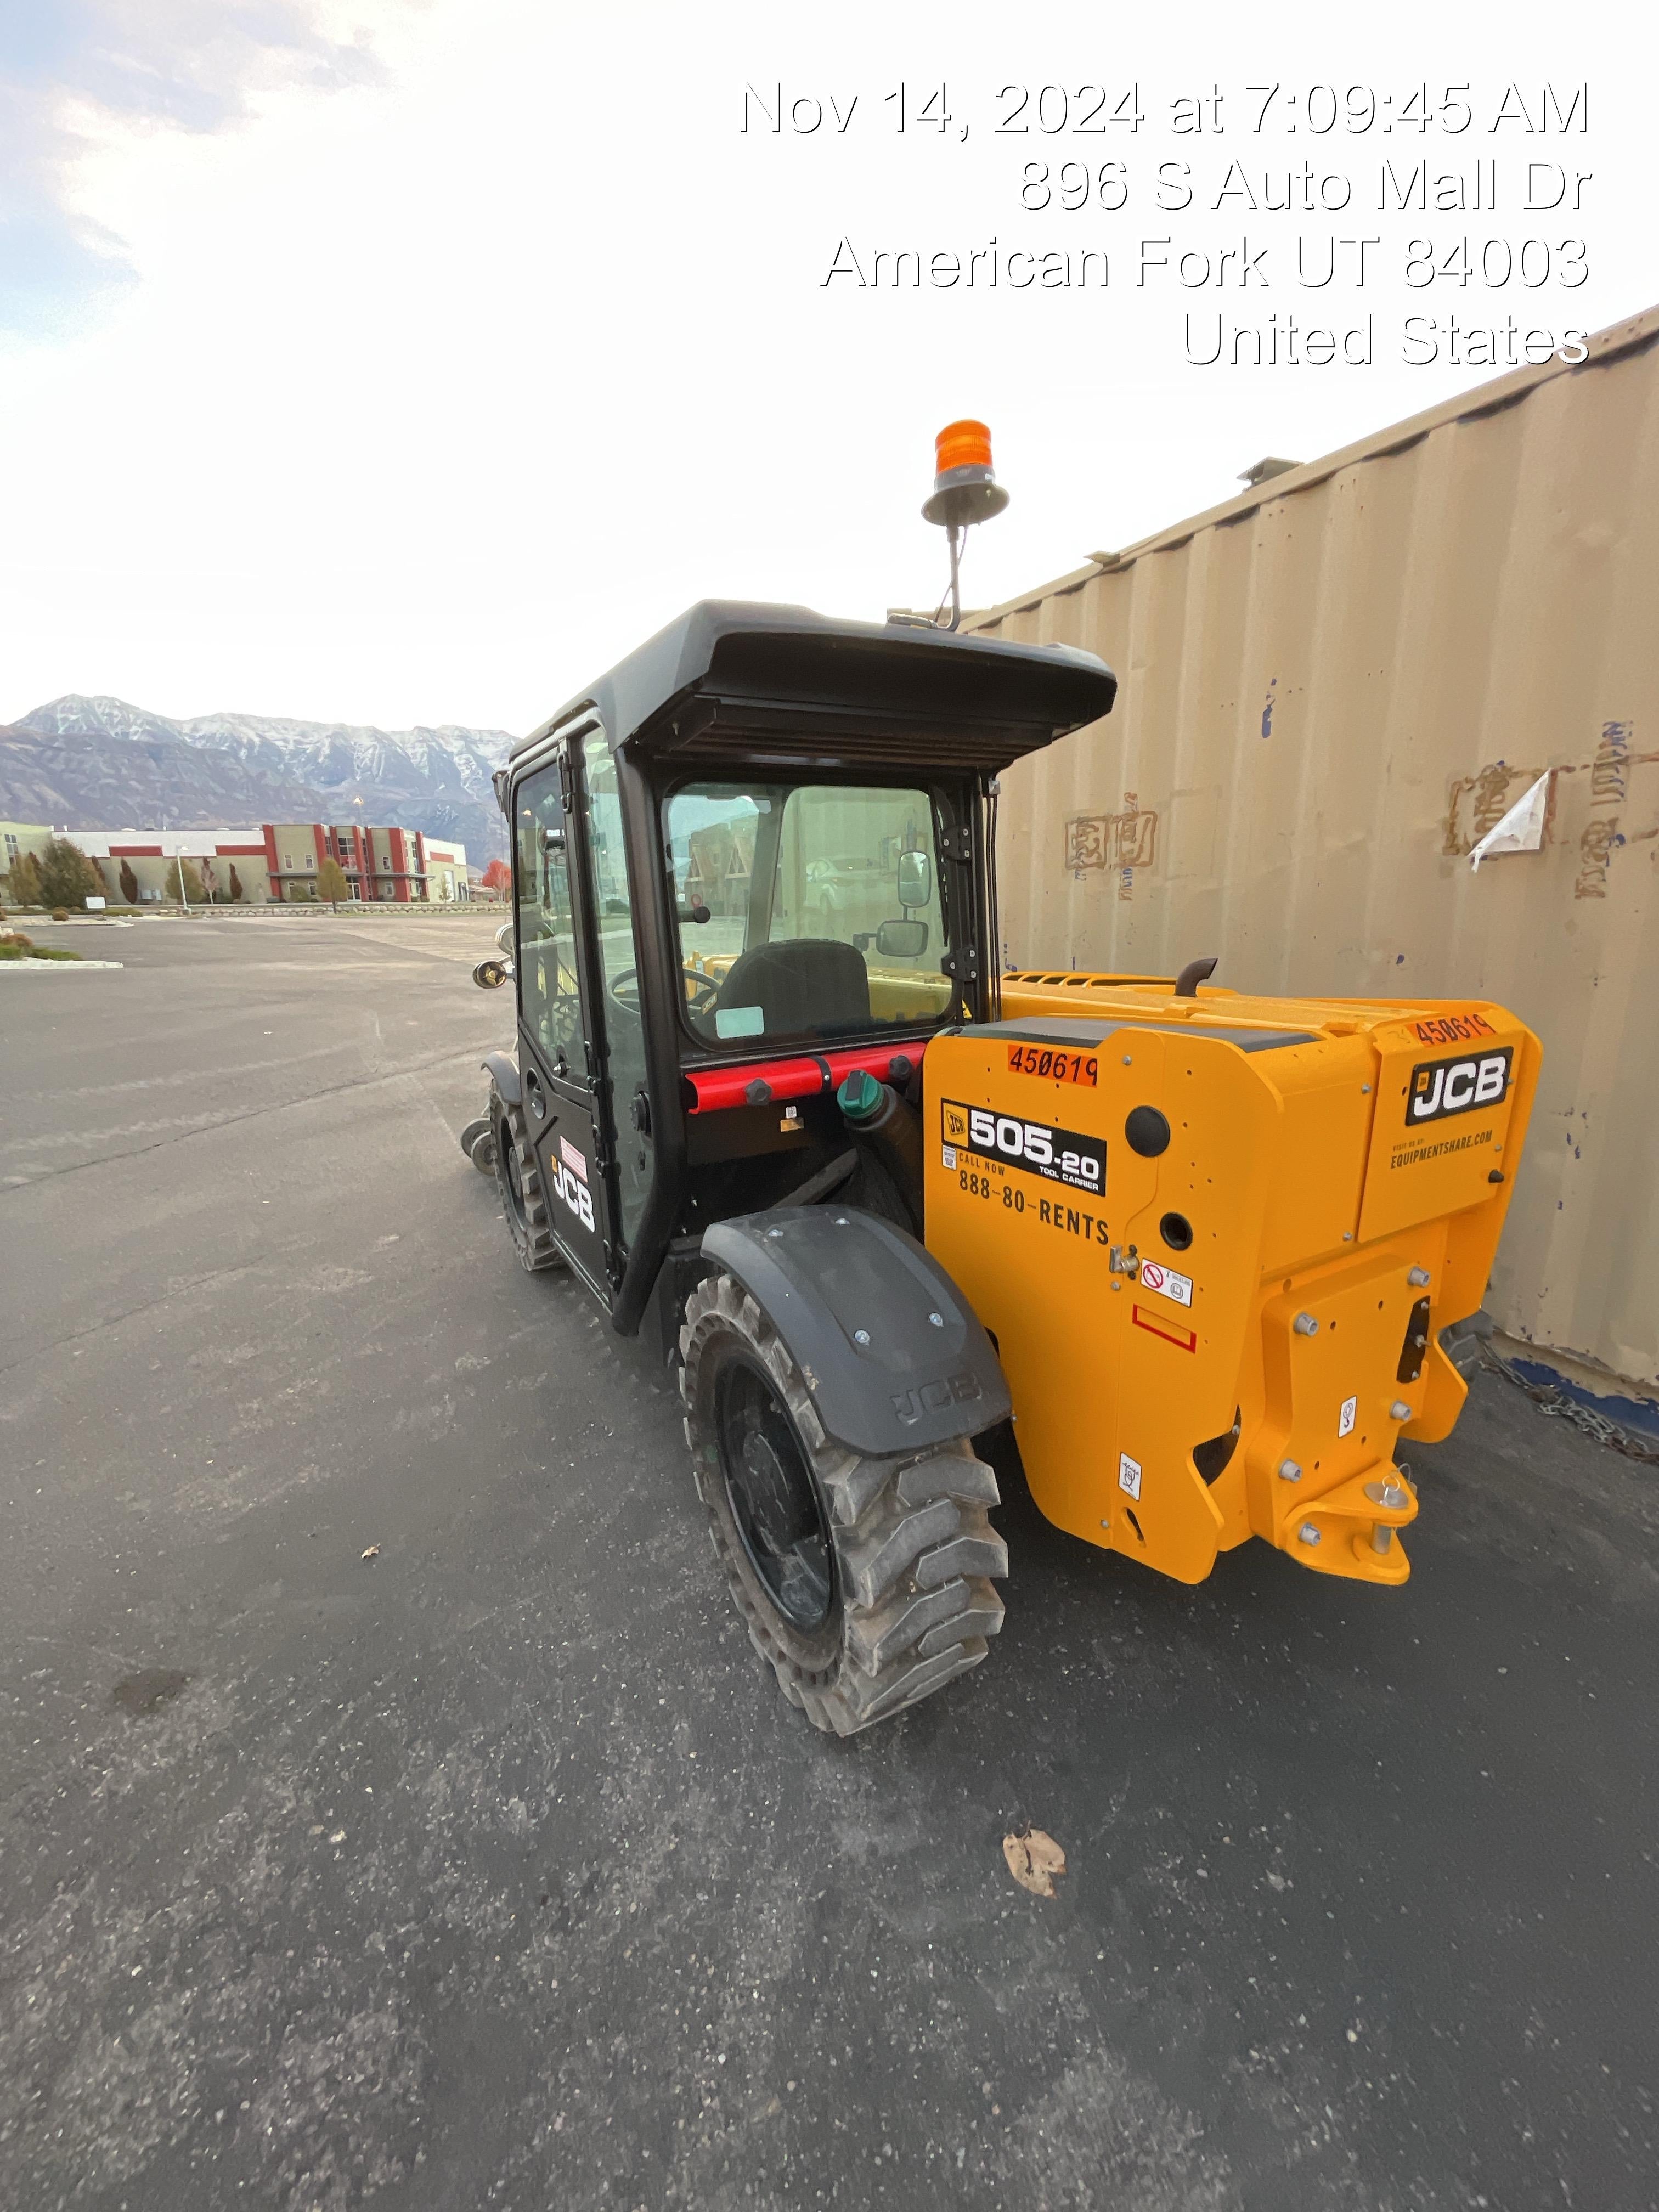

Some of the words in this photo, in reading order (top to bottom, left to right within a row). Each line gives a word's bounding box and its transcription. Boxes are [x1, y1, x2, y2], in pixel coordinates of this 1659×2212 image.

[1415, 1013, 1496, 1045] 450619
[1009, 1046, 1098, 1086] 450619
[1413, 1056, 1506, 1117] JCB
[949, 1114, 964, 1133] JCB
[959, 1152, 980, 1168] CALL
[985, 1161, 1005, 1176] NOW
[1390, 1129, 1493, 1169] EQUIPMENTSHARE.COM
[553, 1160, 595, 1233] JCB
[1039, 1165, 1059, 1178] TOOL
[1062, 1173, 1098, 1191] CARRIER
[958, 1170, 1109, 1246] 888-80-RENTS
[889, 1372, 983, 1425] JCB
